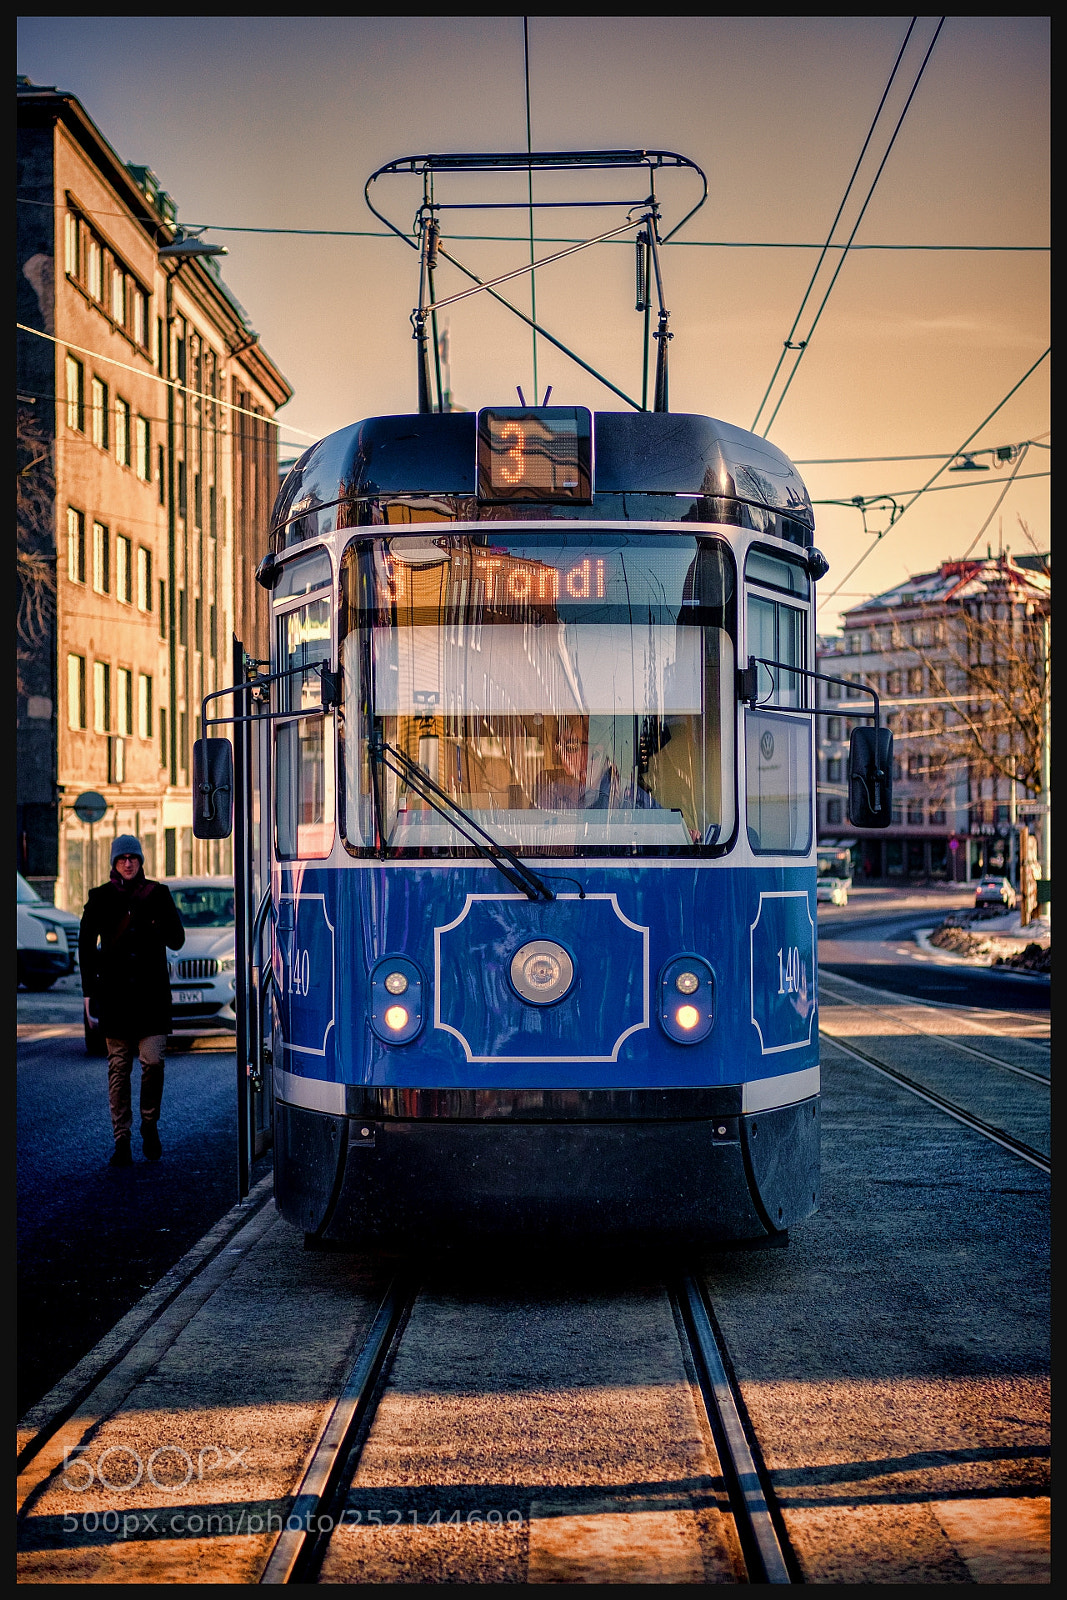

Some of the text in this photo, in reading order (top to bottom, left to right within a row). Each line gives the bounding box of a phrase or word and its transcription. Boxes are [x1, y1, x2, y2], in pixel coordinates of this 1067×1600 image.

[501, 423, 524, 483] 3
[476, 559, 604, 598] Tondi
[287, 949, 310, 997] 140
[777, 946, 800, 994] 140
